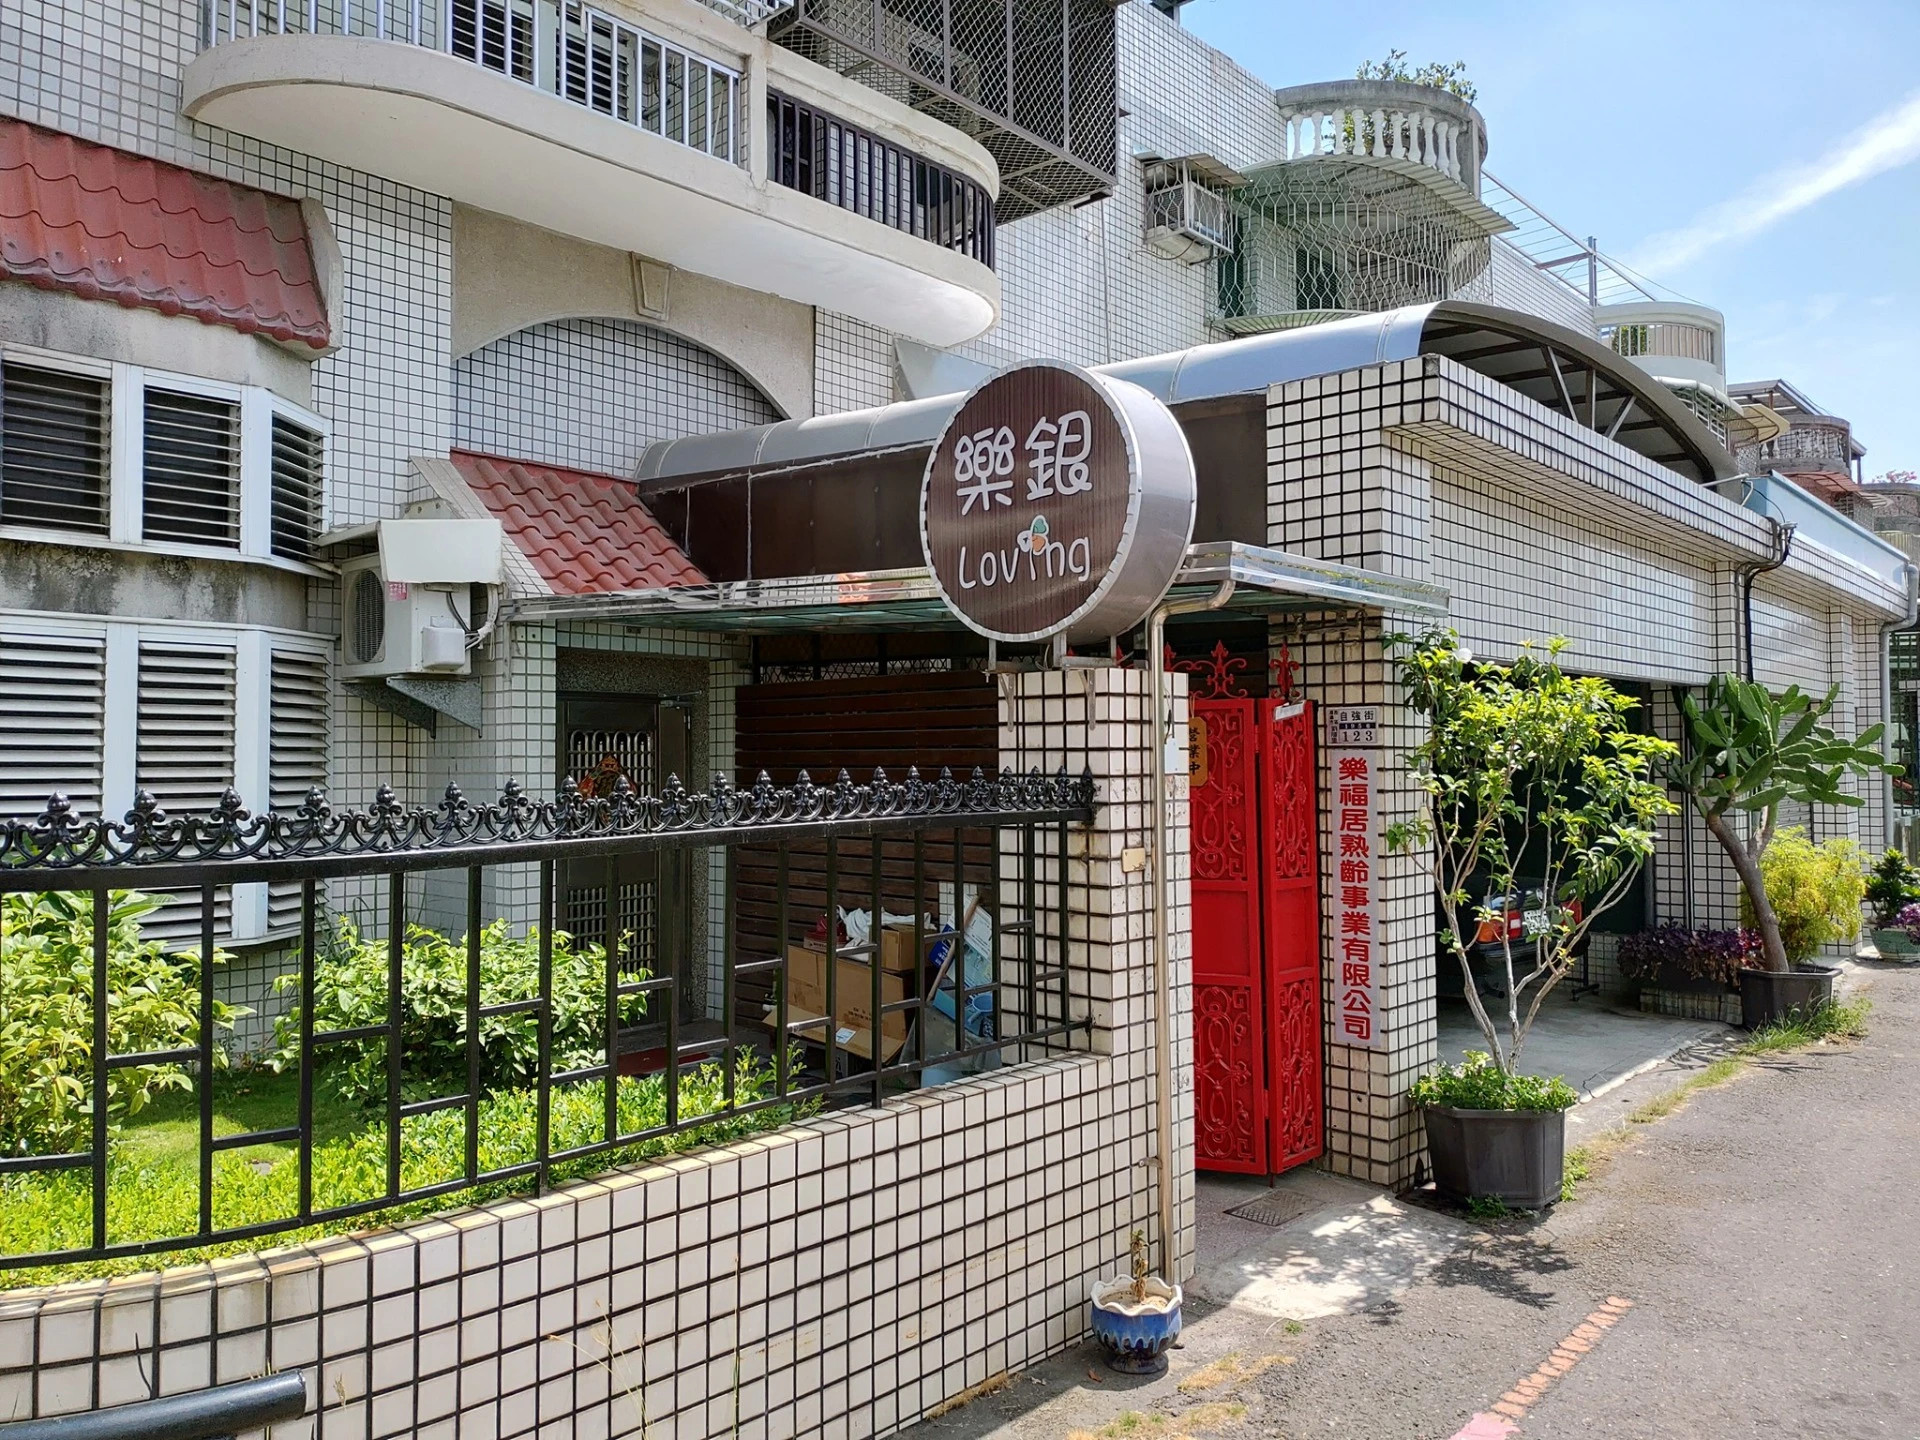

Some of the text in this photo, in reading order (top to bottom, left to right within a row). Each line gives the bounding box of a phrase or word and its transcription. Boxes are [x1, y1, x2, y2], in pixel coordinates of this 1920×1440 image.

[954, 410, 1093, 516] 樂銀
[958, 536, 1091, 590] Loving
[1340, 710, 1374, 722] 自強街
[1342, 730, 1373, 742] 123
[1189, 727, 1201, 776] 營業中
[1338, 757, 1372, 1041] 樂福居熟齡事業有限公司
